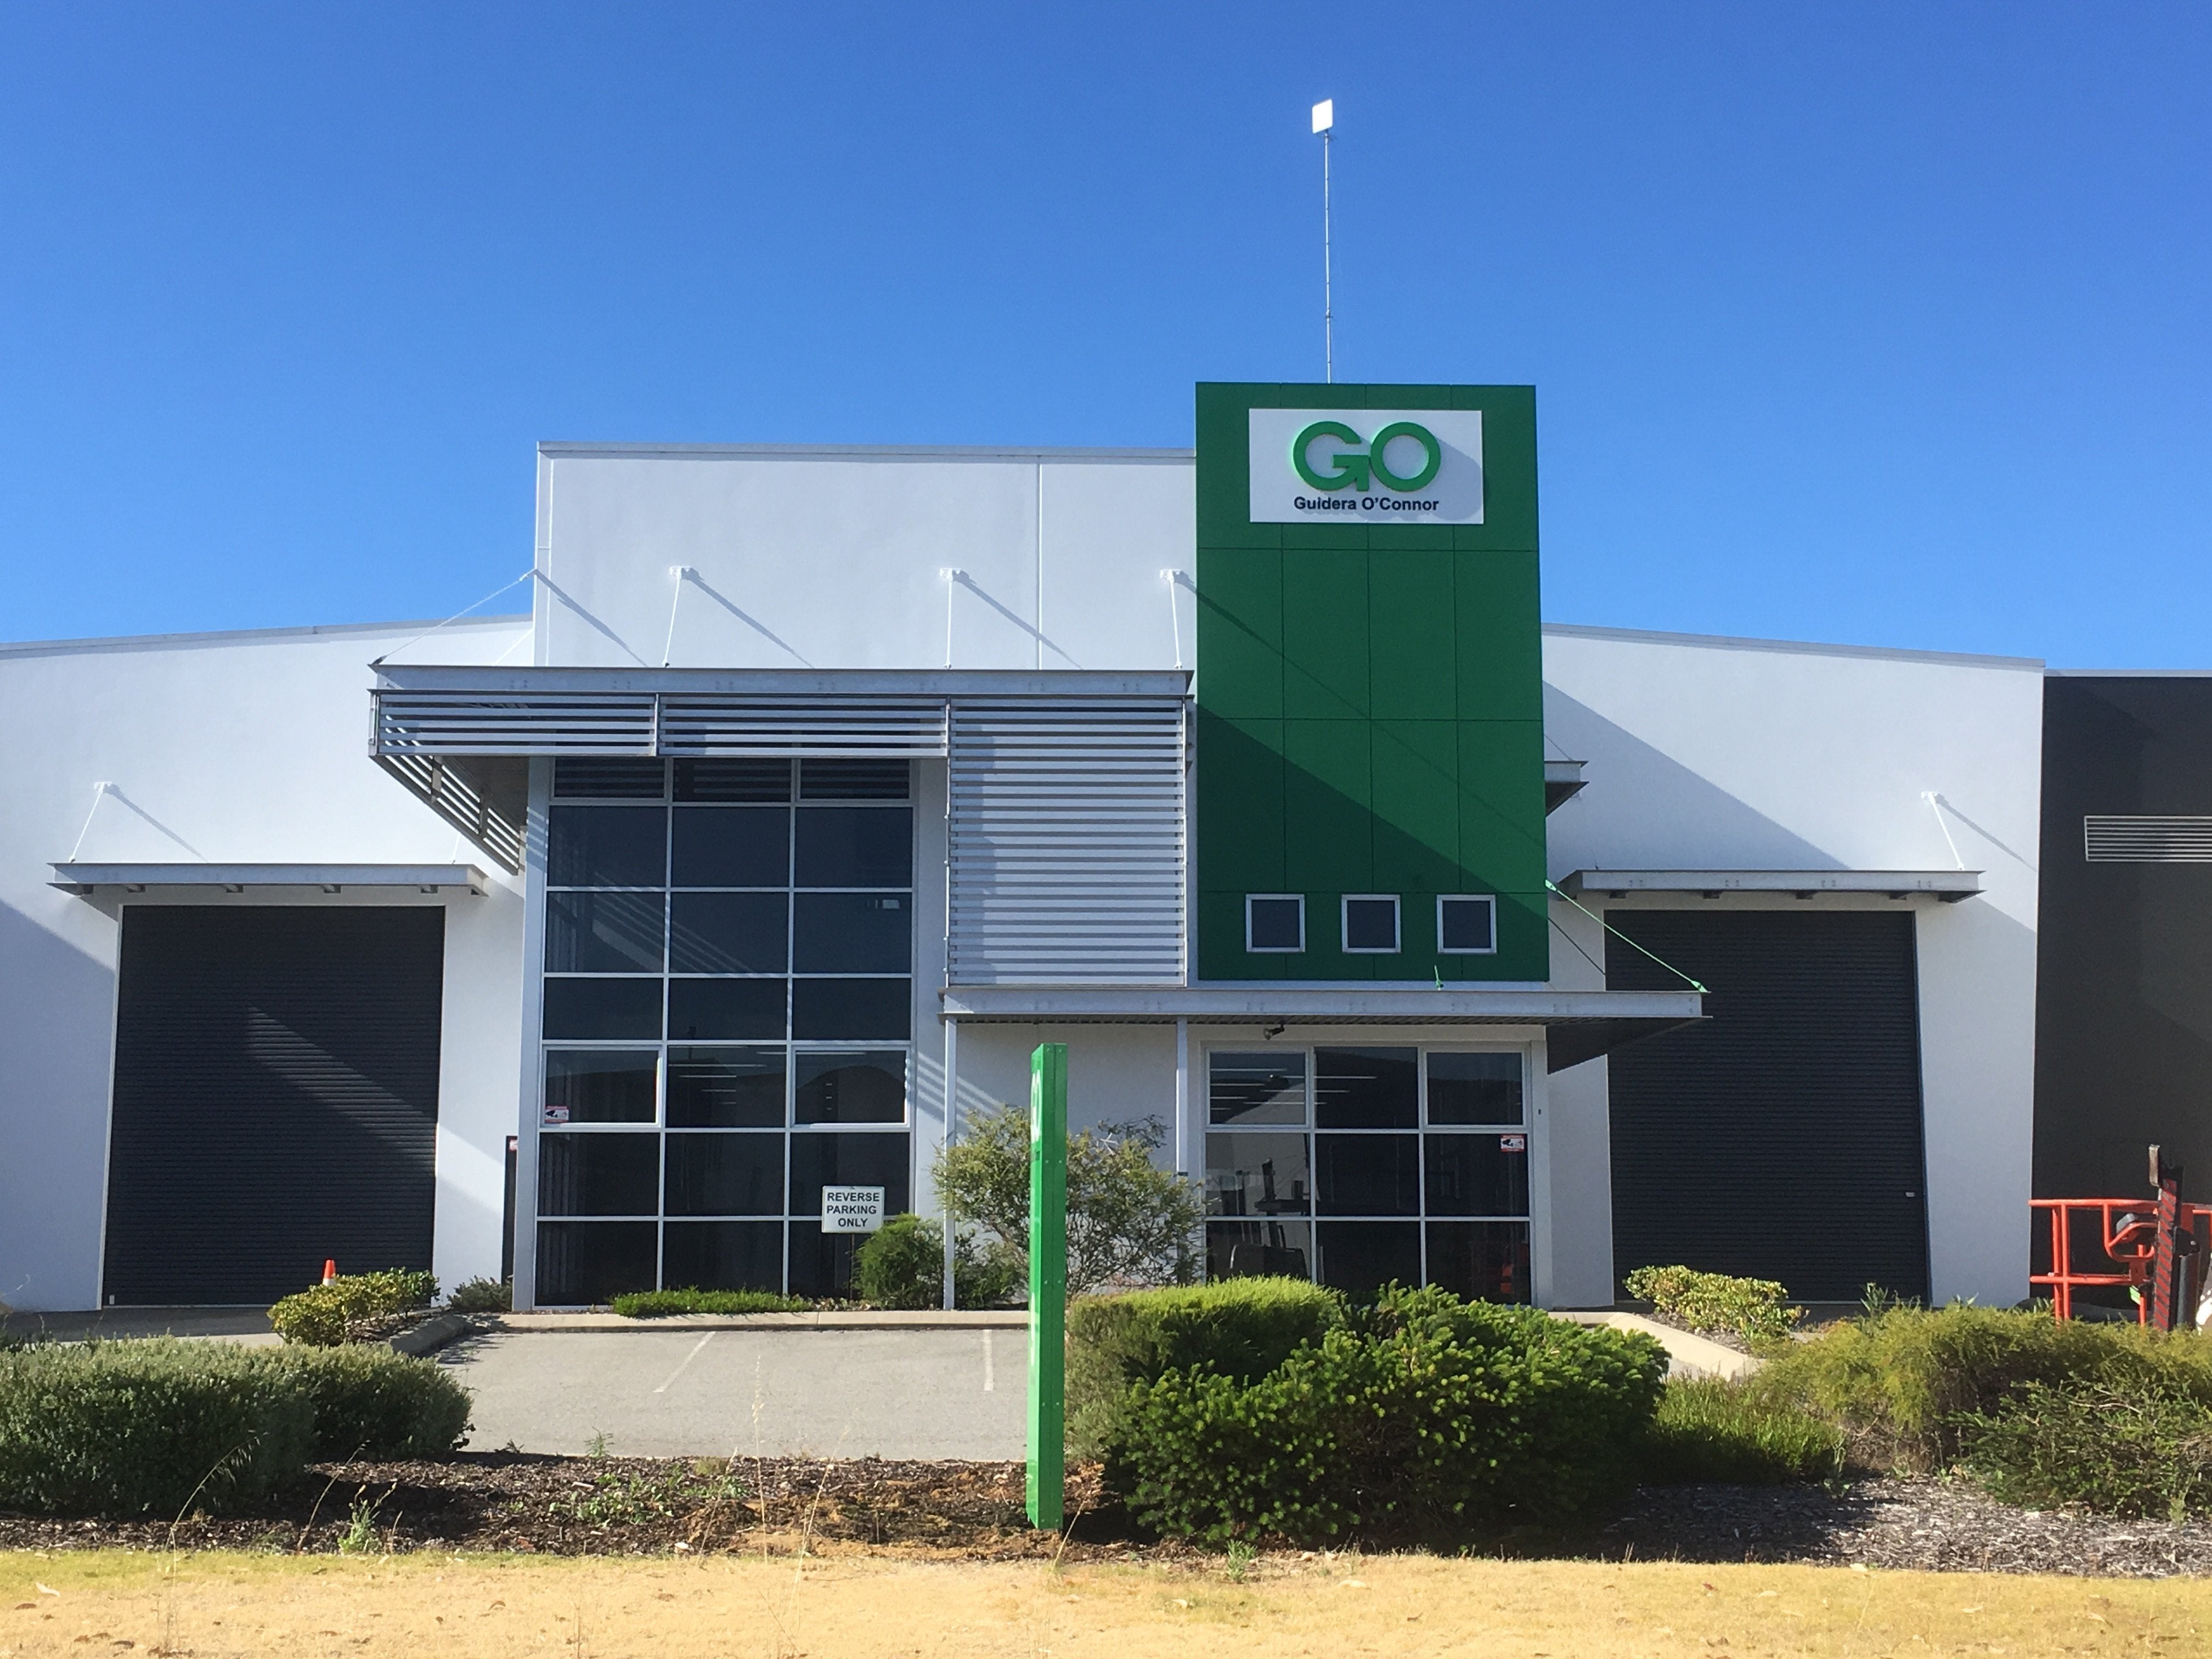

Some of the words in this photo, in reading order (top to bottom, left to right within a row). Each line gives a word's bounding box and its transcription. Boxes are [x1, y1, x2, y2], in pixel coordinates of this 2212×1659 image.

[1293, 421, 1441, 492] GO
[1294, 496, 1357, 510] Guidera
[1362, 497, 1439, 511] O'Connor
[827, 1192, 880, 1202] REVERSE
[826, 1205, 877, 1215] PARKING
[838, 1218, 868, 1227] ONLY
